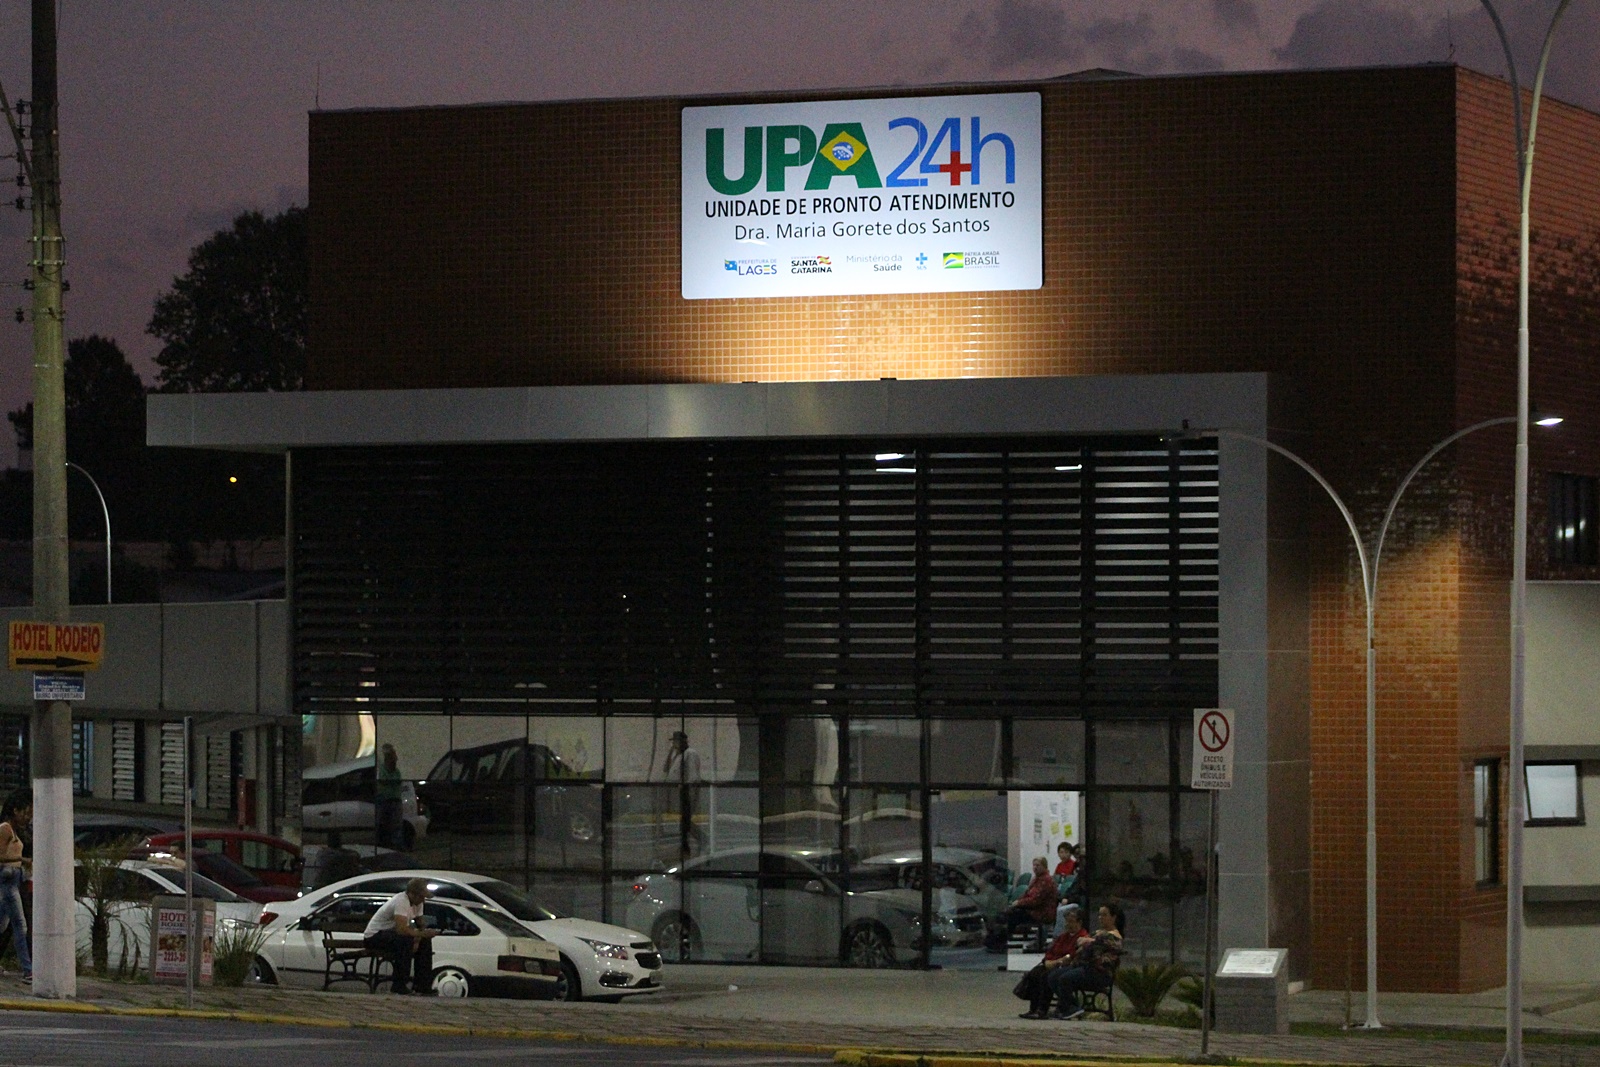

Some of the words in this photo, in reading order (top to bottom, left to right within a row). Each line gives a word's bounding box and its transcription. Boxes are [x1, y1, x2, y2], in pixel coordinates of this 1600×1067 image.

[706, 122, 883, 196] UPA
[886, 116, 1015, 188] 24h
[705, 199, 781, 218] UNIDADE
[786, 198, 807, 215] DE
[813, 195, 882, 214] PRONTO
[889, 191, 1015, 212] ATENDIMENTO
[735, 225, 769, 240] Dra.
[776, 222, 826, 239] Maria
[832, 221, 892, 237] Gorete
[896, 218, 926, 235] dos
[932, 218, 990, 234] Santos
[791, 259, 818, 267] SANTA
[846, 253, 890, 263] Ministério
[892, 253, 903, 262] da
[964, 256, 1000, 266] BRASIL
[738, 264, 777, 276] LAGES
[791, 266, 832, 274] CATARINA
[873, 263, 902, 272] Saúde
[13, 623, 52, 651] HOTEL
[55, 624, 101, 653] RODEIO
[1203, 755, 1224, 763] EXCETO
[1193, 780, 1231, 788] AUTORIZADOS
[160, 912, 188, 922] HOTE
